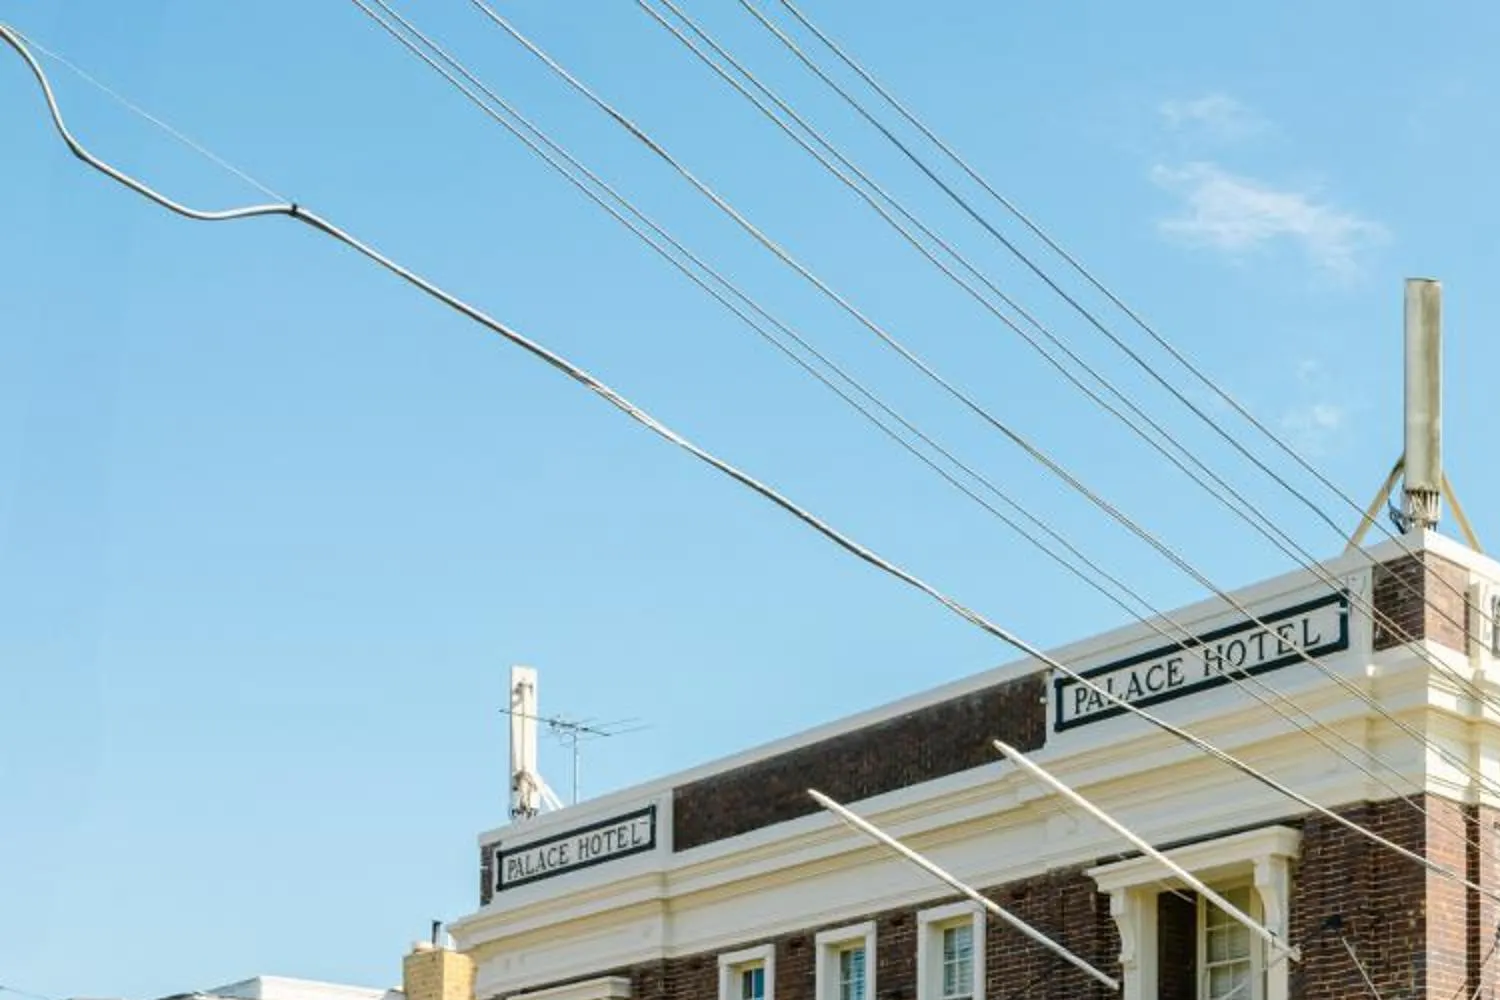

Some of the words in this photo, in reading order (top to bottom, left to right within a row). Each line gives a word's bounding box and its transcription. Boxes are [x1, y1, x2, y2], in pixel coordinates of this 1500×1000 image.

[1074, 656, 1186, 715] PALACE
[1203, 617, 1322, 677] HOTEL
[507, 842, 570, 881] PALACE
[578, 822, 643, 861] HOTEL
